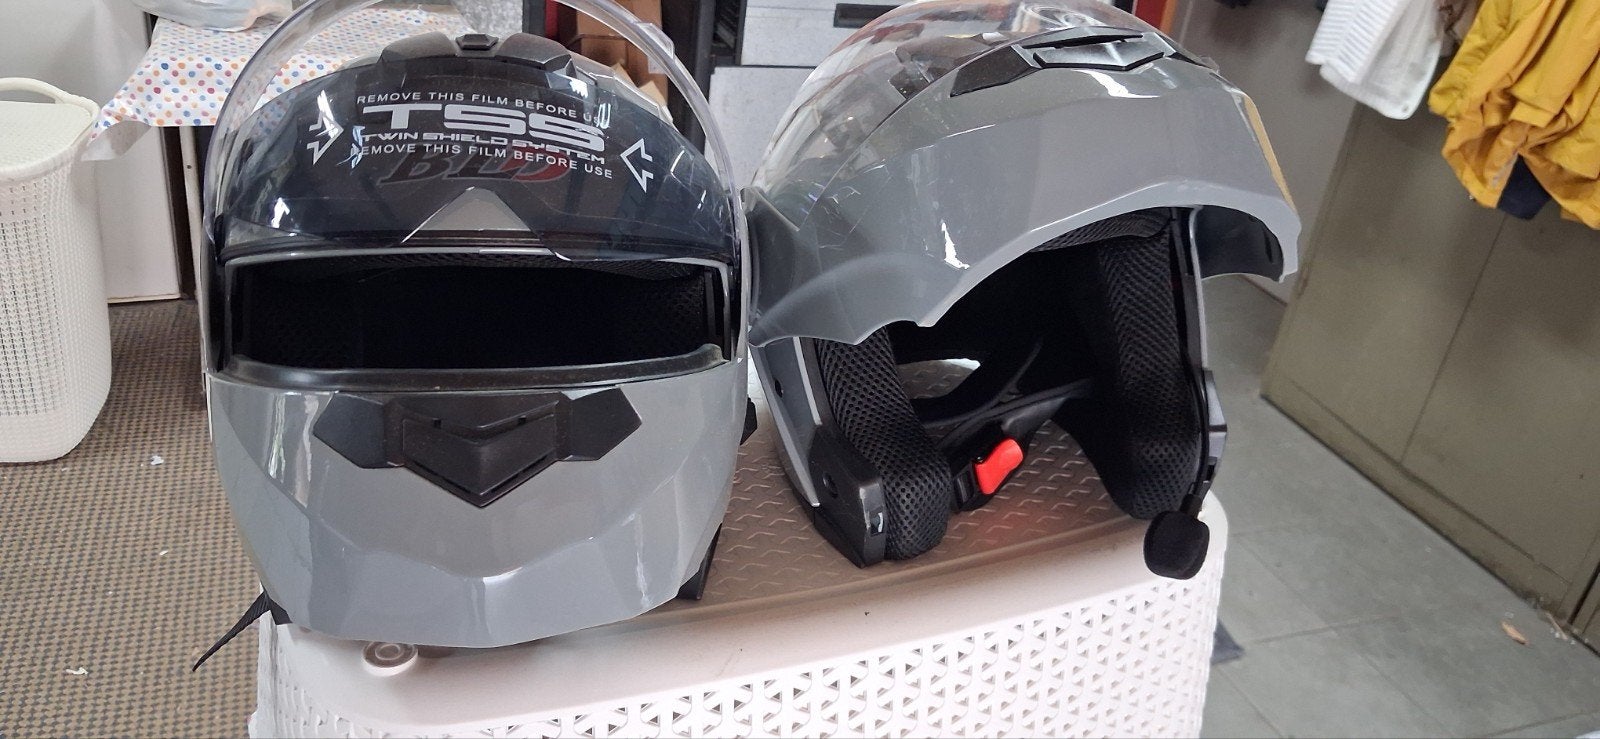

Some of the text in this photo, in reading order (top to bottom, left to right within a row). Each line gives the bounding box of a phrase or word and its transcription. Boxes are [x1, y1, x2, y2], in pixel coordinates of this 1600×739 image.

[356, 91, 610, 128] REMOVE THIS FILM BEFORE US
[362, 103, 605, 152] TSS
[352, 143, 613, 179] EMOVE THIS FILM BEFORE USE
[361, 131, 605, 165] TWIN SHIELD SYSTEM
